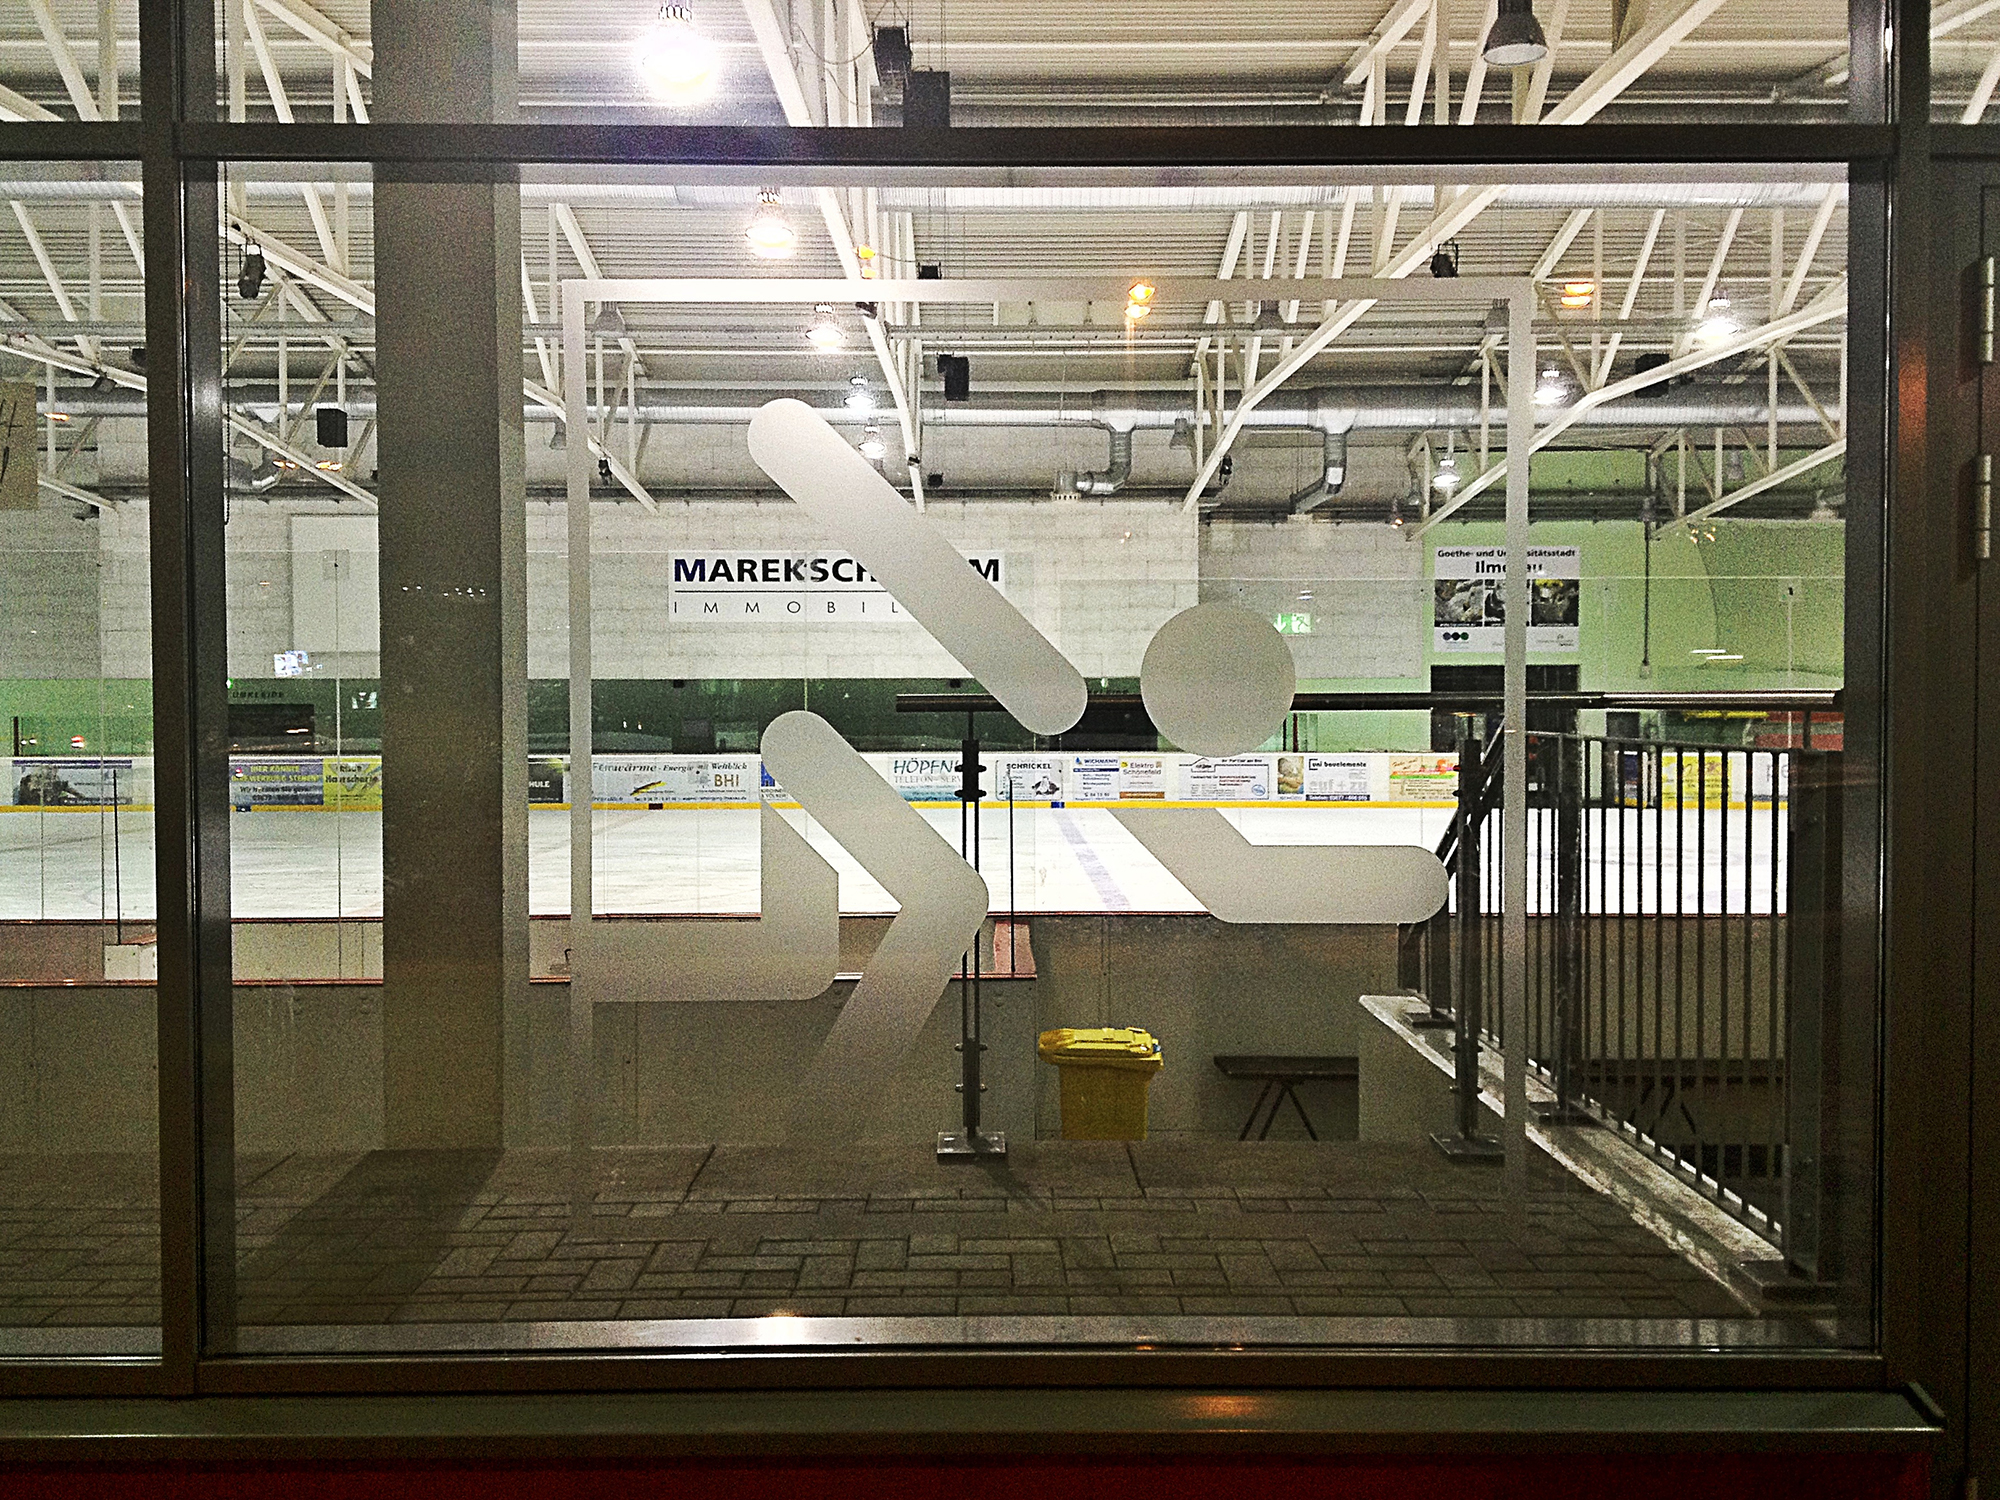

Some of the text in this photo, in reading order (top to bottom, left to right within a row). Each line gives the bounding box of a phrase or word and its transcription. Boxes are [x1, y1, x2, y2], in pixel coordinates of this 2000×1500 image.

[1476, 549, 1495, 557] und
[674, 558, 1000, 583] MAREKSCHM
[674, 601, 900, 614] IMMOBIL
[894, 758, 959, 774] HÖPFN
[528, 780, 550, 788] HULE
[714, 774, 740, 788] BHI
